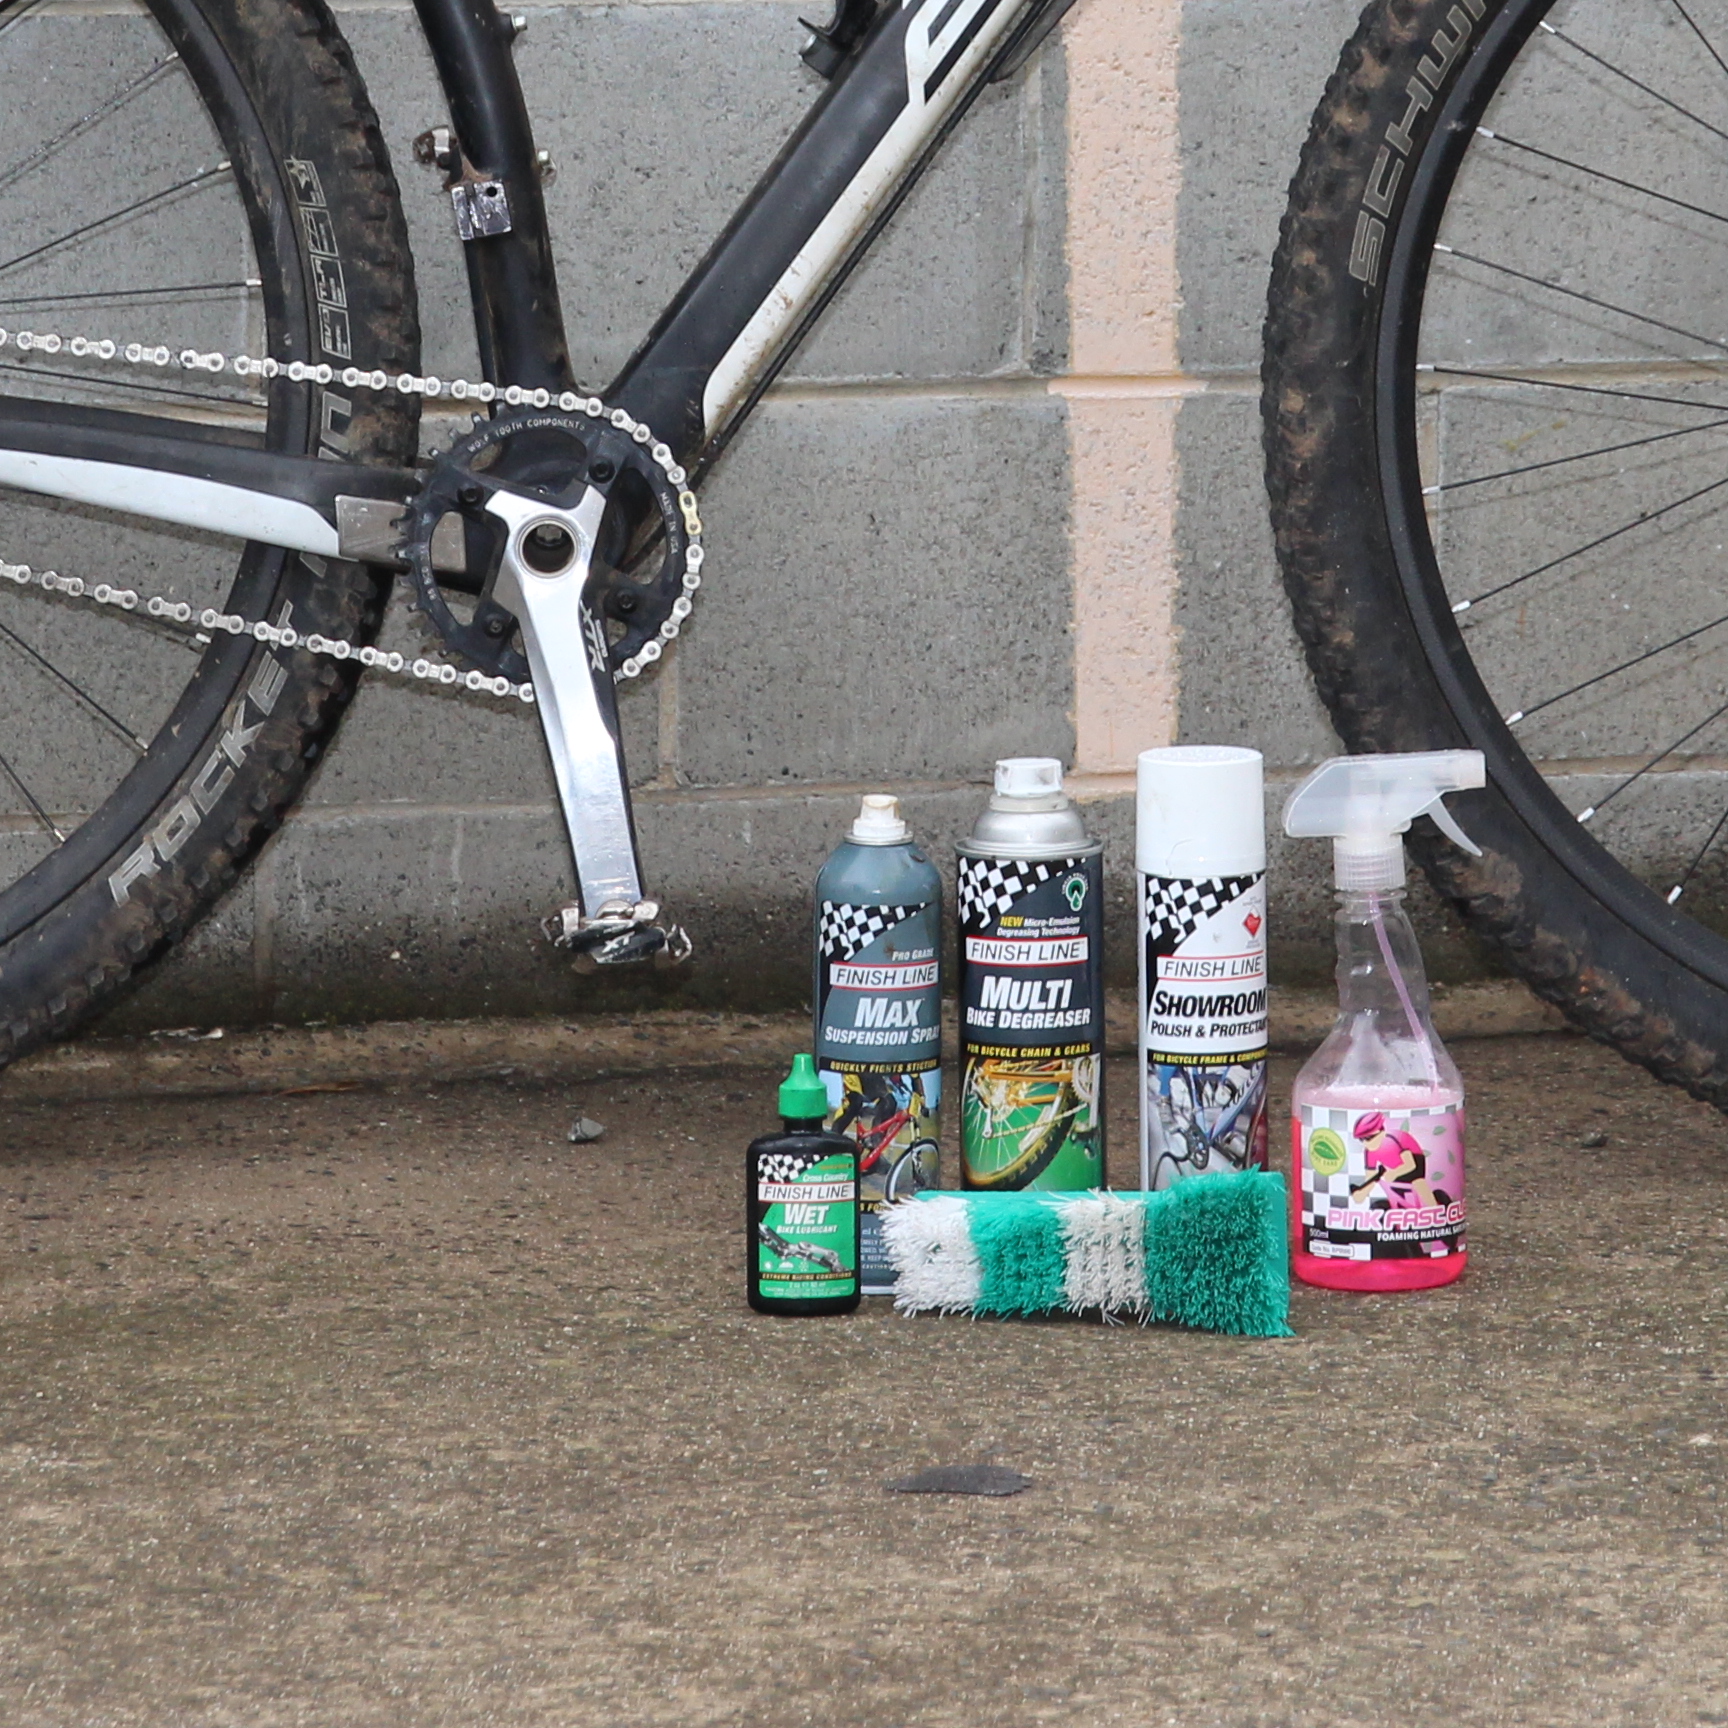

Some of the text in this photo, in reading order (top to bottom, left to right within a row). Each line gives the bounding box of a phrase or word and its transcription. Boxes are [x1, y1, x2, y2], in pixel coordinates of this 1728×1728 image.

[580, 600, 605, 672] XTR
[108, 599, 299, 908] ROCKET
[1000, 916, 1024, 927] NEW
[892, 951, 910, 961] PRO
[971, 941, 1081, 961] FINISH LINE
[836, 965, 936, 985] FINISH LINE
[1164, 956, 1262, 977] FINISH LINE
[980, 975, 1073, 1010] MULTI
[1154, 987, 1267, 1018] SHOWROOM
[854, 997, 922, 1028] MAX
[966, 1006, 1091, 1029] BIKE DEGREASER
[825, 1026, 908, 1046] SUSPENSION
[1151, 1020, 1192, 1037] POLISH
[1195, 1025, 1205, 1037] &
[967, 1043, 979, 1053] FOR
[981, 1046, 1018, 1057] BICYCLE
[1020, 1047, 1052, 1057] CHAIN
[1064, 1043, 1090, 1055] GEARS
[1167, 1054, 1198, 1064] BICYCLE
[1200, 1055, 1228, 1064] FRAME
[830, 1061, 867, 1073] QUICKLY
[764, 1185, 848, 1199] FINISH LINE
[785, 1203, 829, 1225] WET
[1326, 1208, 1381, 1230] PINK
[1384, 1205, 1446, 1230] FAST
[776, 1225, 838, 1233] BIKE LUBRICANT
[1377, 1231, 1419, 1242] FOAMING
[1421, 1227, 1452, 1240] NATURAL
